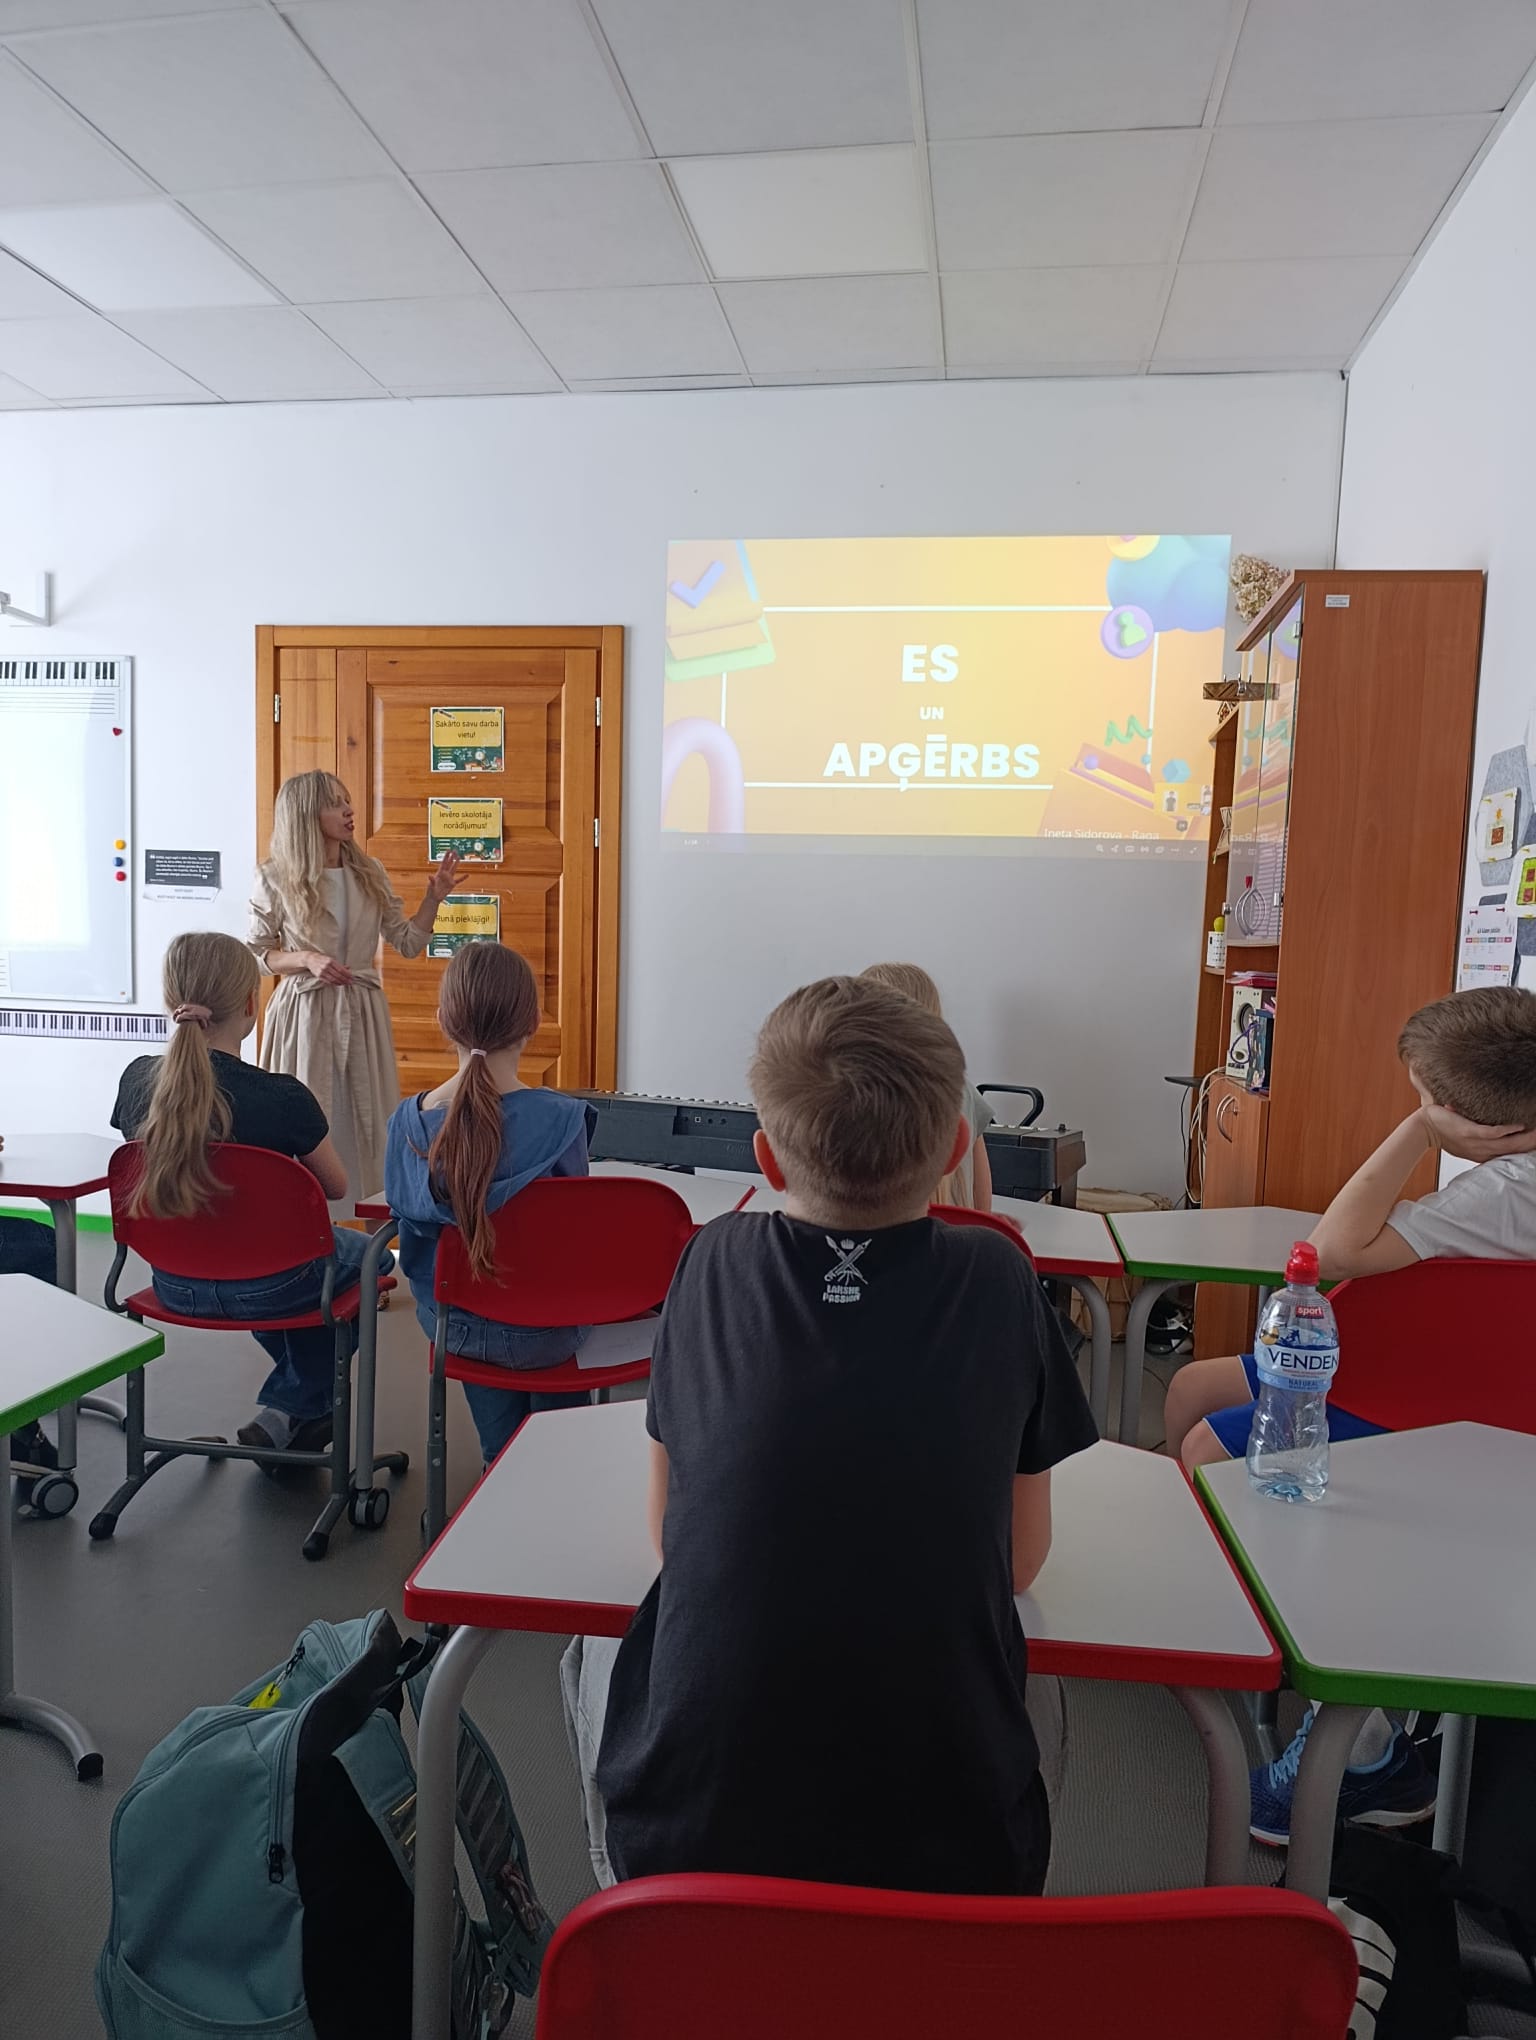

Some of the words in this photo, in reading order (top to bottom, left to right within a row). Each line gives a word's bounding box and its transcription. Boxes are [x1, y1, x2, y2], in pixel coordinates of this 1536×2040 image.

[901, 644, 959, 682] ES
[919, 706, 944, 720] UN
[479, 720, 499, 728] darba
[823, 734, 1040, 791] APĢĒRBS
[1044, 828, 1072, 838] Ineta
[1074, 829, 1122, 839] Sidorova
[1297, 1306, 1323, 1315] sport
